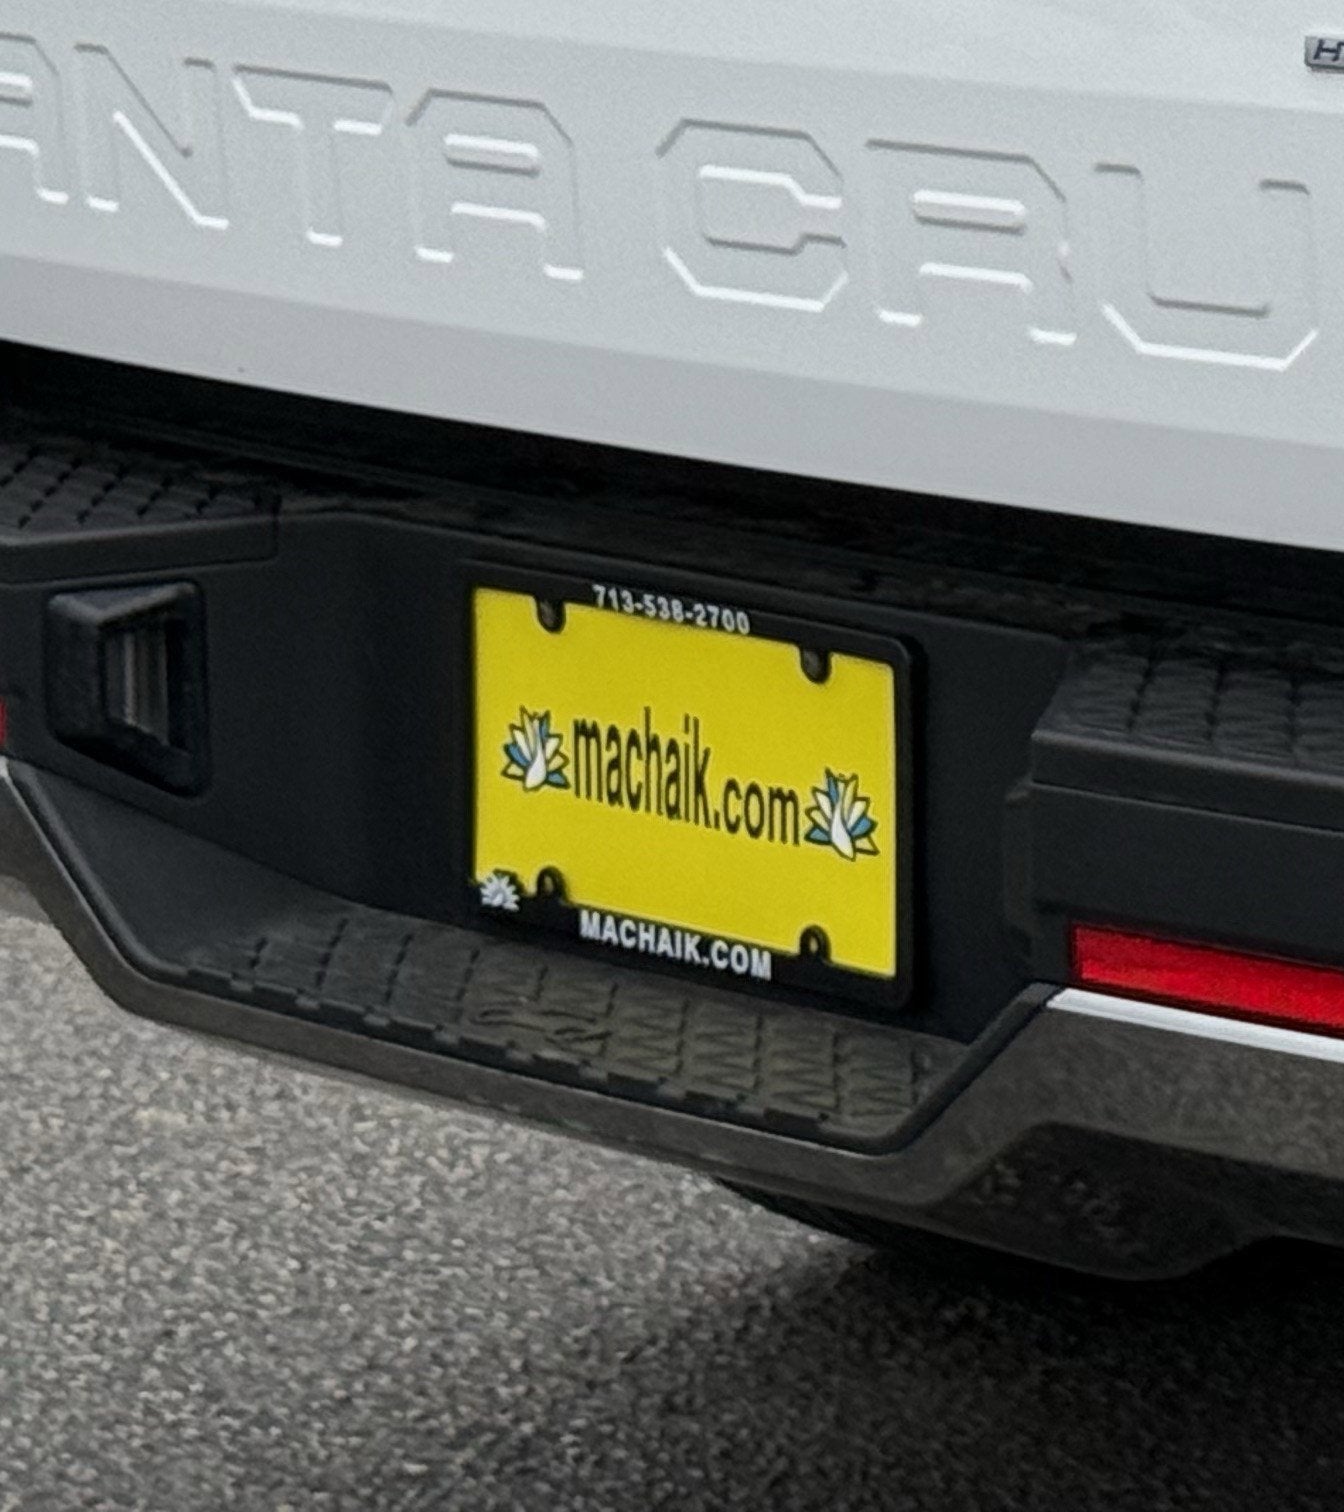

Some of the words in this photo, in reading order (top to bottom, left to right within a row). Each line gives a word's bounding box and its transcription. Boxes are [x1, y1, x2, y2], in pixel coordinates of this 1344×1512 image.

[593, 585, 751, 635] 713-538-2700
[573, 706, 800, 846] machaik.com
[579, 908, 773, 980] MACHAIK.COM
